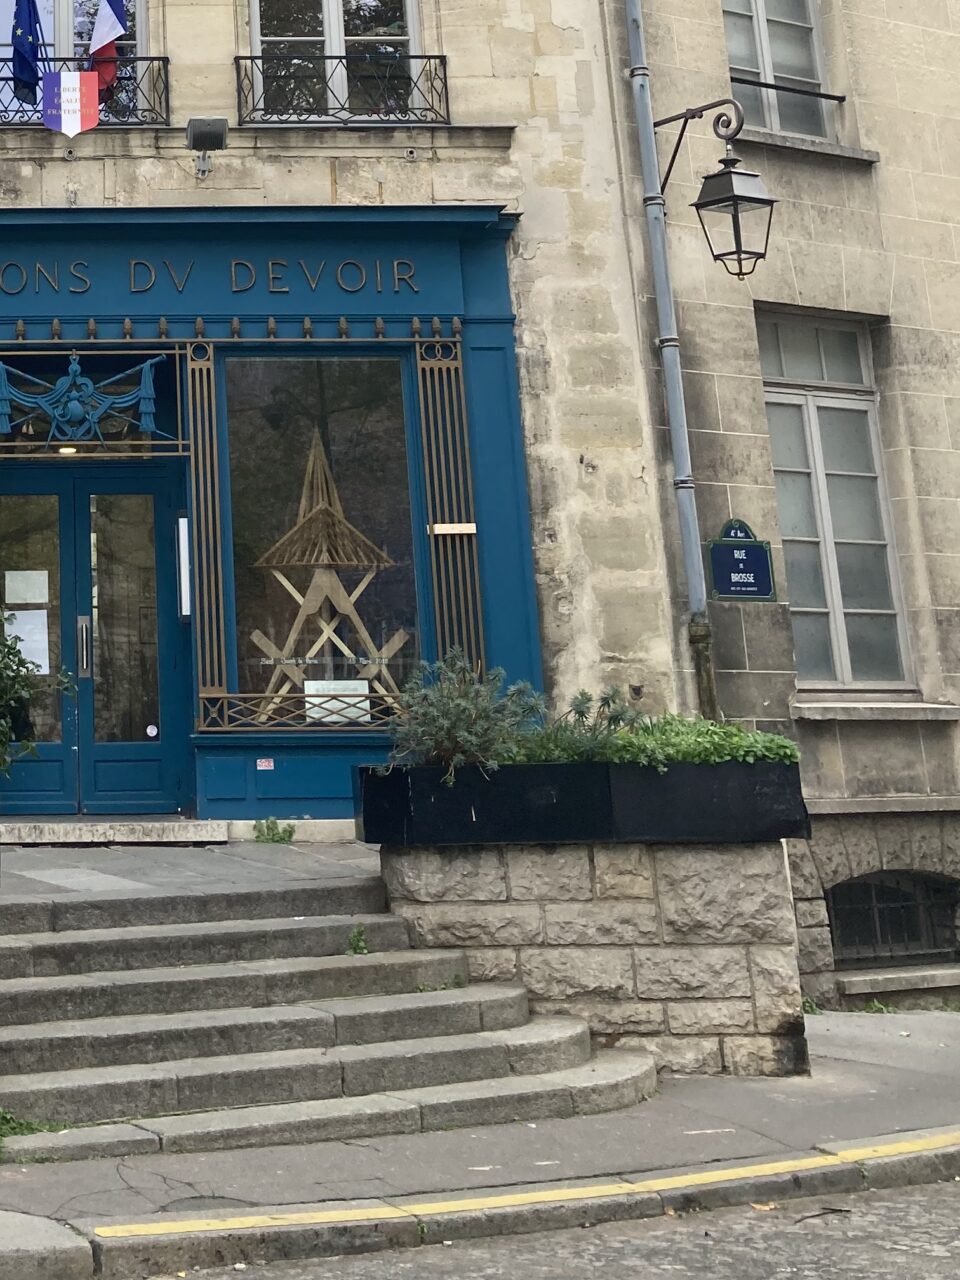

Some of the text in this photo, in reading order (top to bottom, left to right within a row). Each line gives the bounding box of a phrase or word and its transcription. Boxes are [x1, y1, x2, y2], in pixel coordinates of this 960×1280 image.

[231, 259, 419, 293] DEVOIR
[733, 549, 747, 559] RUE
[730, 572, 755, 583] BROSSE
